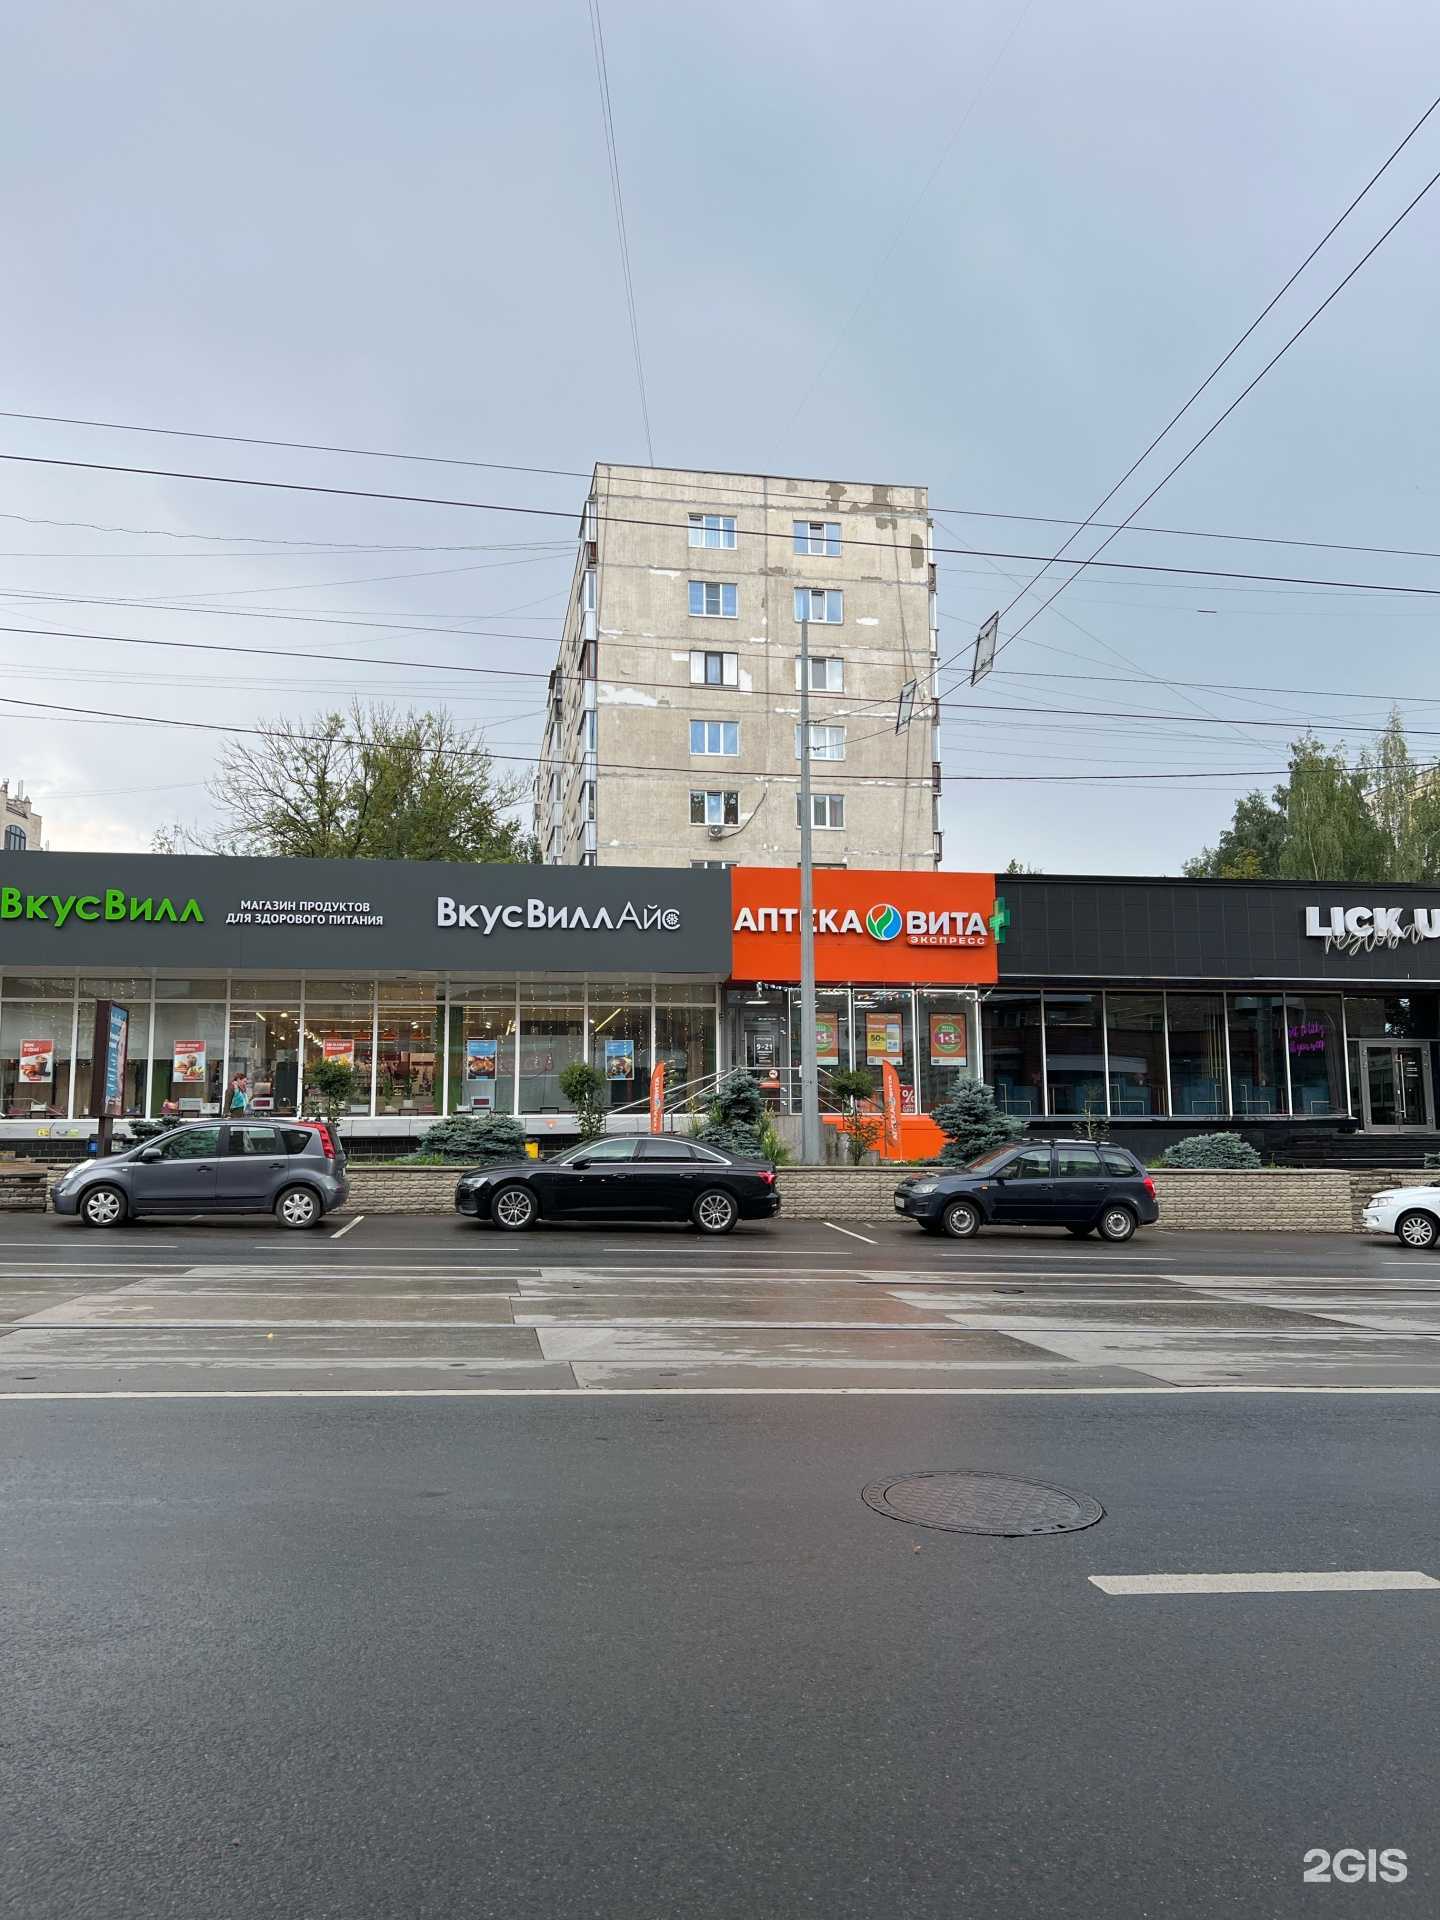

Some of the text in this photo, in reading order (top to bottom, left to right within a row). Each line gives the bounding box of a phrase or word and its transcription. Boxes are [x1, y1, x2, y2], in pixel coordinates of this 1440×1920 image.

[1, 887, 205, 928] ВкусВилл
[240, 900, 370, 912] МАГАЗИН ПРОДУКТОВ
[225, 913, 384, 926] ДЛЯ ЗДОРОВОГО ПИТАНИЯ
[733, 907, 988, 936] АПТКА ВИТА
[1305, 906, 1404, 937] LICK
[909, 936, 986, 946] ЭКСПРЕСС
